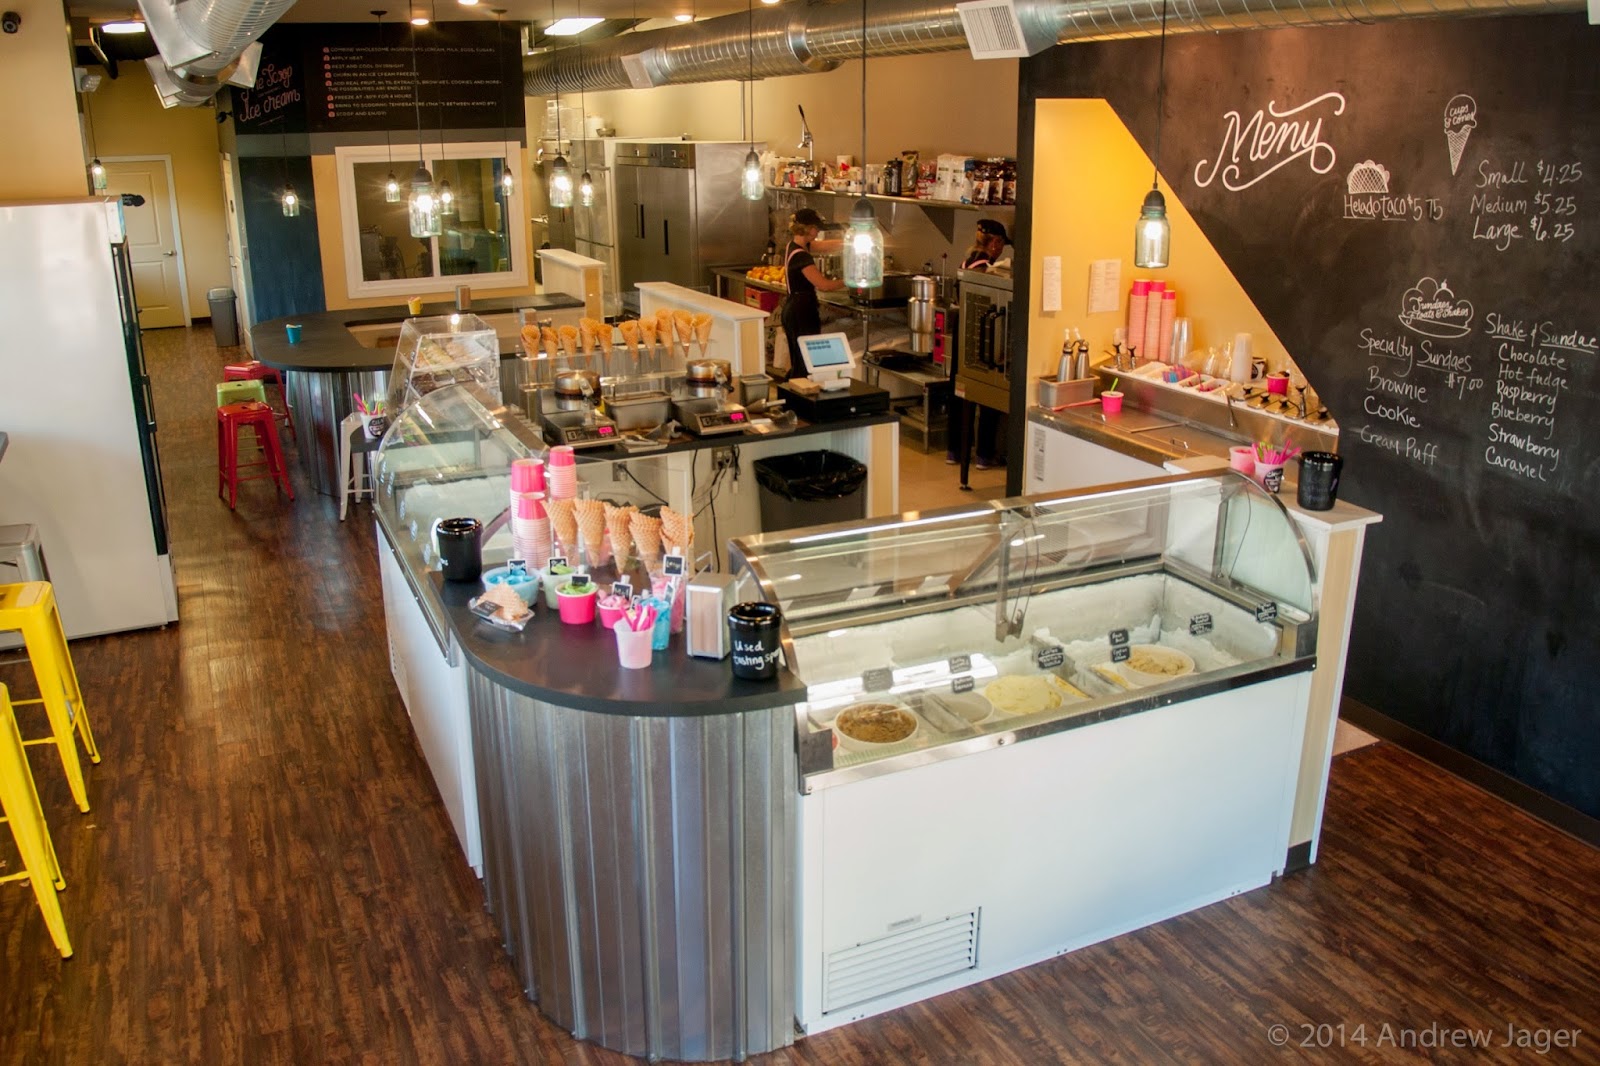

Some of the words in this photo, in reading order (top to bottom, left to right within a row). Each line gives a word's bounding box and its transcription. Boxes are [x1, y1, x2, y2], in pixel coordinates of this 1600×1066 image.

[1475, 159, 1529, 189] Small
[1537, 159, 1583, 187] $4.25
[1469, 193, 1528, 215] Medium
[1534, 190, 1577, 216] $5.25
[1472, 215, 1524, 251] Large
[1529, 214, 1575, 243] $6.25
[1485, 312, 1528, 343] Shake
[1539, 320, 1599, 354] Sundae
[1357, 328, 1414, 378] Specialty
[1416, 339, 1472, 374] Sundaes
[1498, 342, 1567, 371] Chocolate
[1366, 365, 1428, 403] Brownie
[1496, 379, 1557, 415] Raspberry
[1498, 363, 1524, 383] Hot
[1525, 367, 1569, 400] fudge
[1363, 395, 1421, 428] Cookie
[1491, 401, 1556, 440] Blueberry
[1360, 424, 1399, 455] Cream
[1405, 436, 1438, 466] Puff
[1485, 445, 1547, 482] Caramel
[1488, 422, 1560, 472] Strawberry
[734, 640, 765, 652] Used
